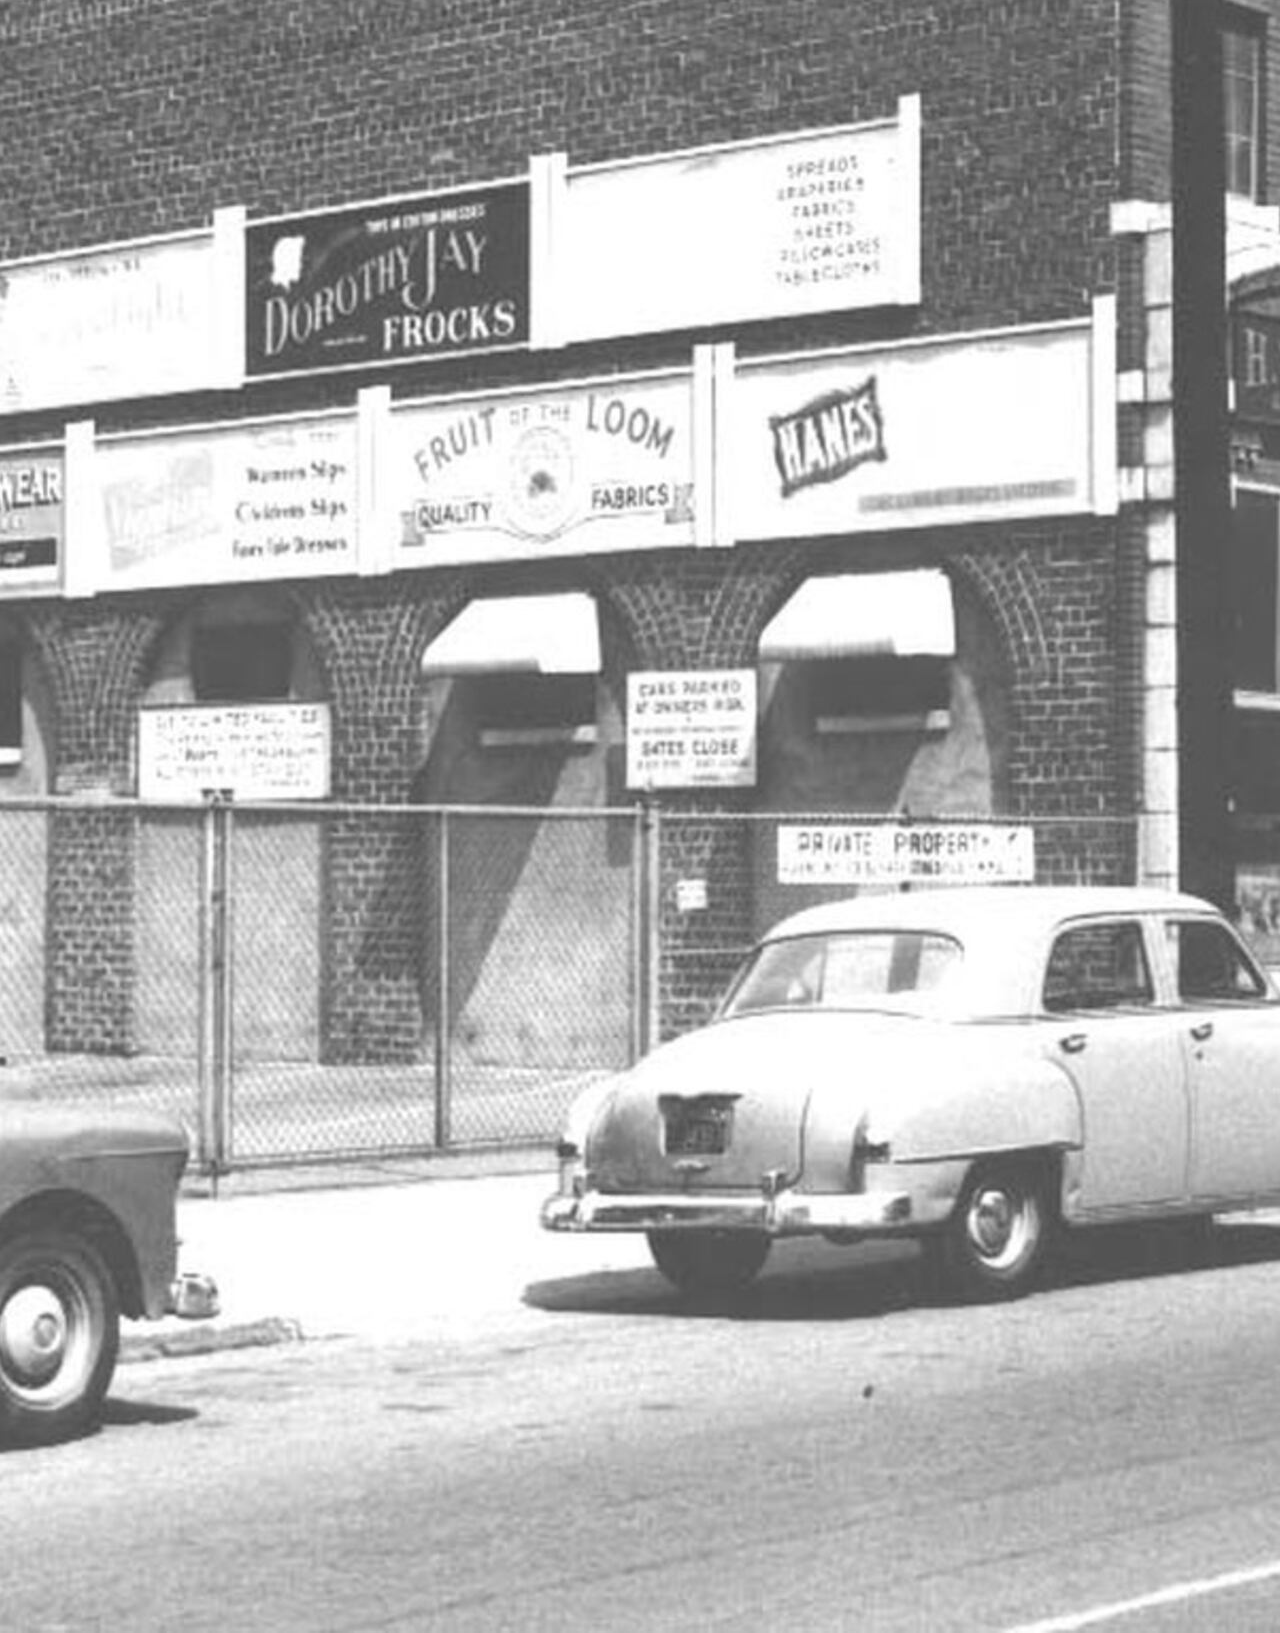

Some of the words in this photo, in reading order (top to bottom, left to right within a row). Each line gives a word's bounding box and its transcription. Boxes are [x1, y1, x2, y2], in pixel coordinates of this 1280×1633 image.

[265, 234, 419, 356] DOROTHY
[402, 229, 487, 310] JAY
[383, 300, 516, 351] FROCKS
[413, 407, 496, 483] FRUIT
[510, 407, 529, 426] OF
[540, 404, 571, 421] THE
[586, 394, 674, 459] LOOM
[782, 393, 880, 483] HANES
[417, 501, 492, 529] QUALITY
[591, 483, 669, 510] FABRICS
[692, 738, 739, 755] CLOSE
[798, 832, 872, 855] PRIVATE
